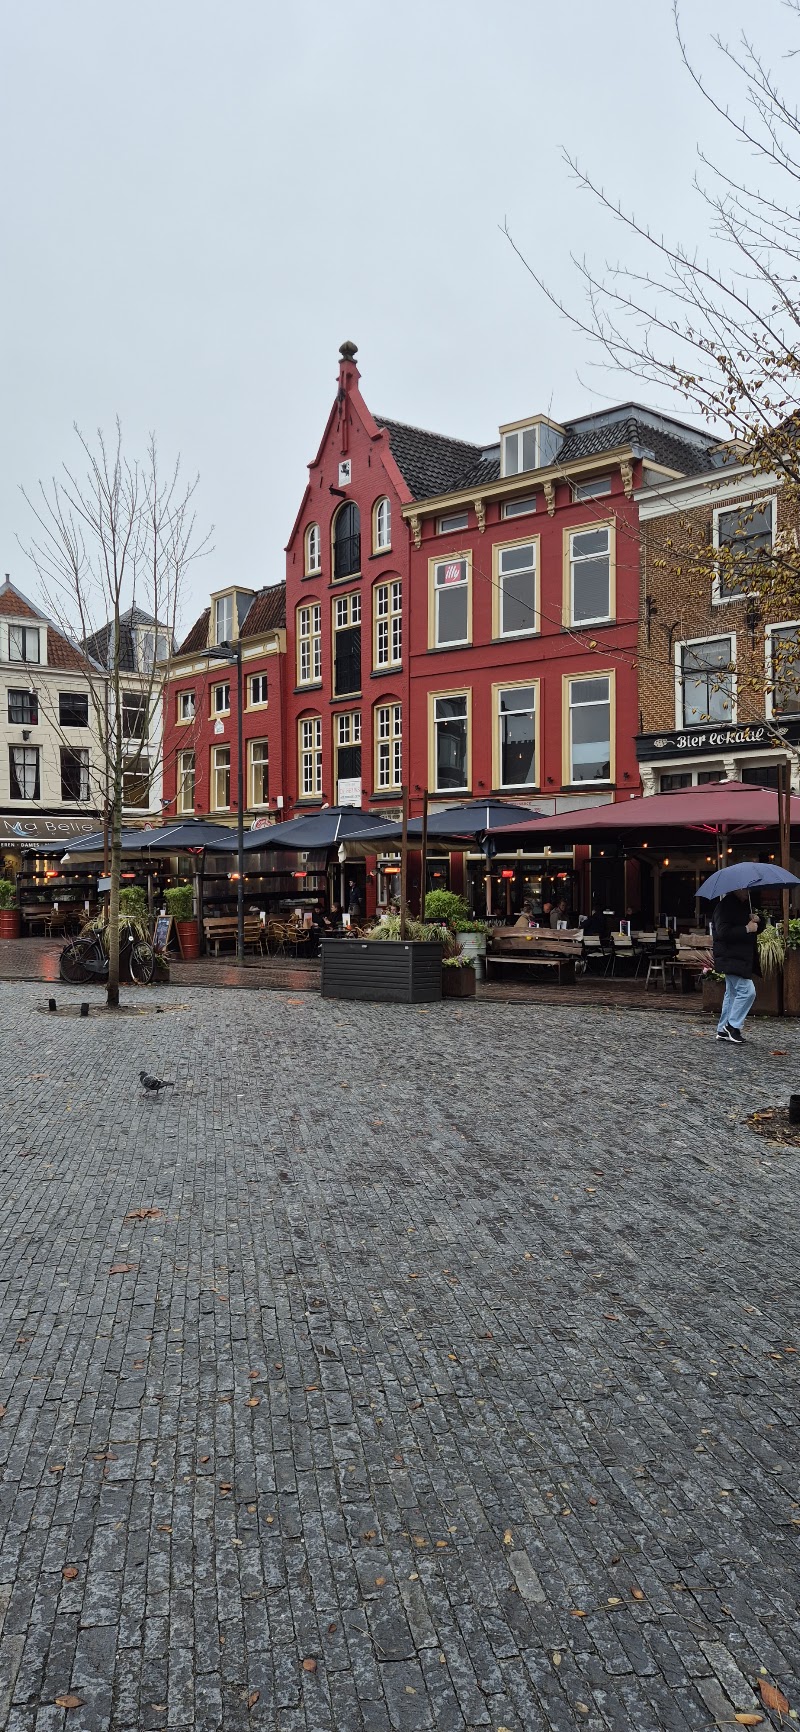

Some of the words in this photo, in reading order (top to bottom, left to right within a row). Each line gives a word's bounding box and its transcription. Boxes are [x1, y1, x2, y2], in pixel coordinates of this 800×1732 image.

[445, 564, 460, 581] illy
[677, 734, 706, 748] Bier
[3, 820, 38, 832] Ma
[45, 821, 94, 832] Belle
